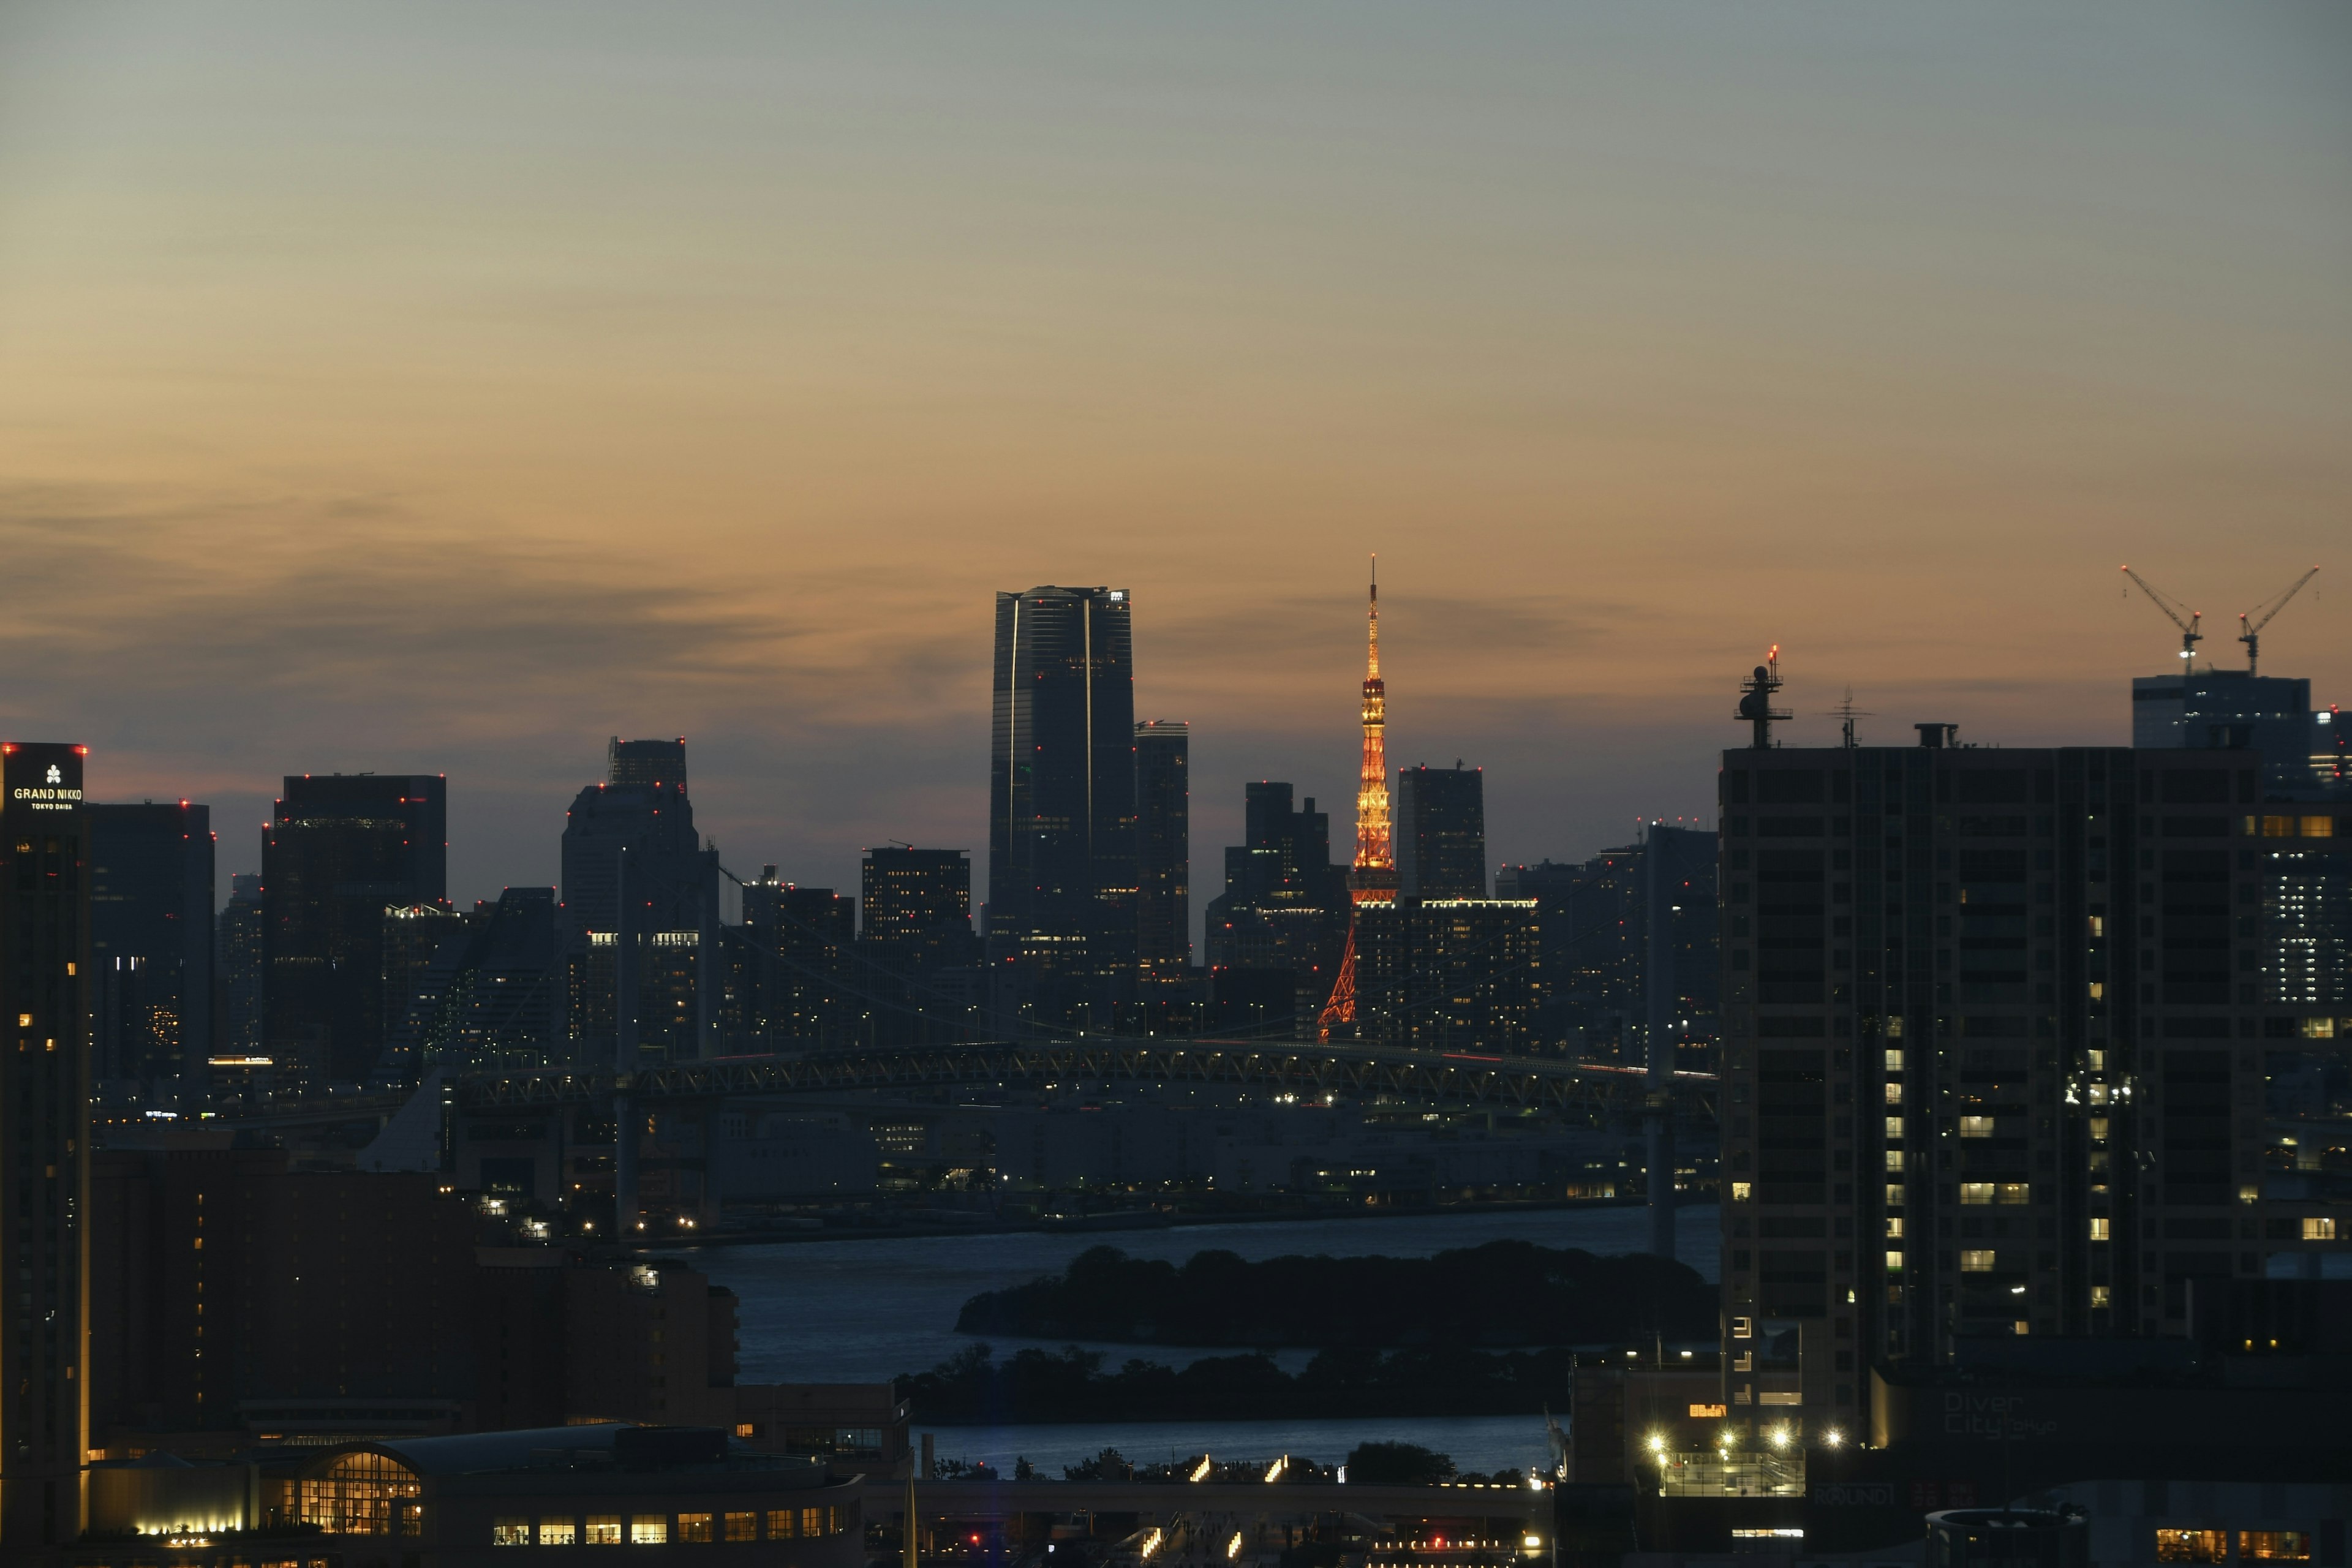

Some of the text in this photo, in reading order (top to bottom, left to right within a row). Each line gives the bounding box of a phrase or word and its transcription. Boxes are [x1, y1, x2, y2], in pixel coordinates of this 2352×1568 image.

[14, 788, 82, 801] GRAND NIKKO
[1945, 1392, 2024, 1412] Diver
[1944, 1413, 2002, 1440] City
